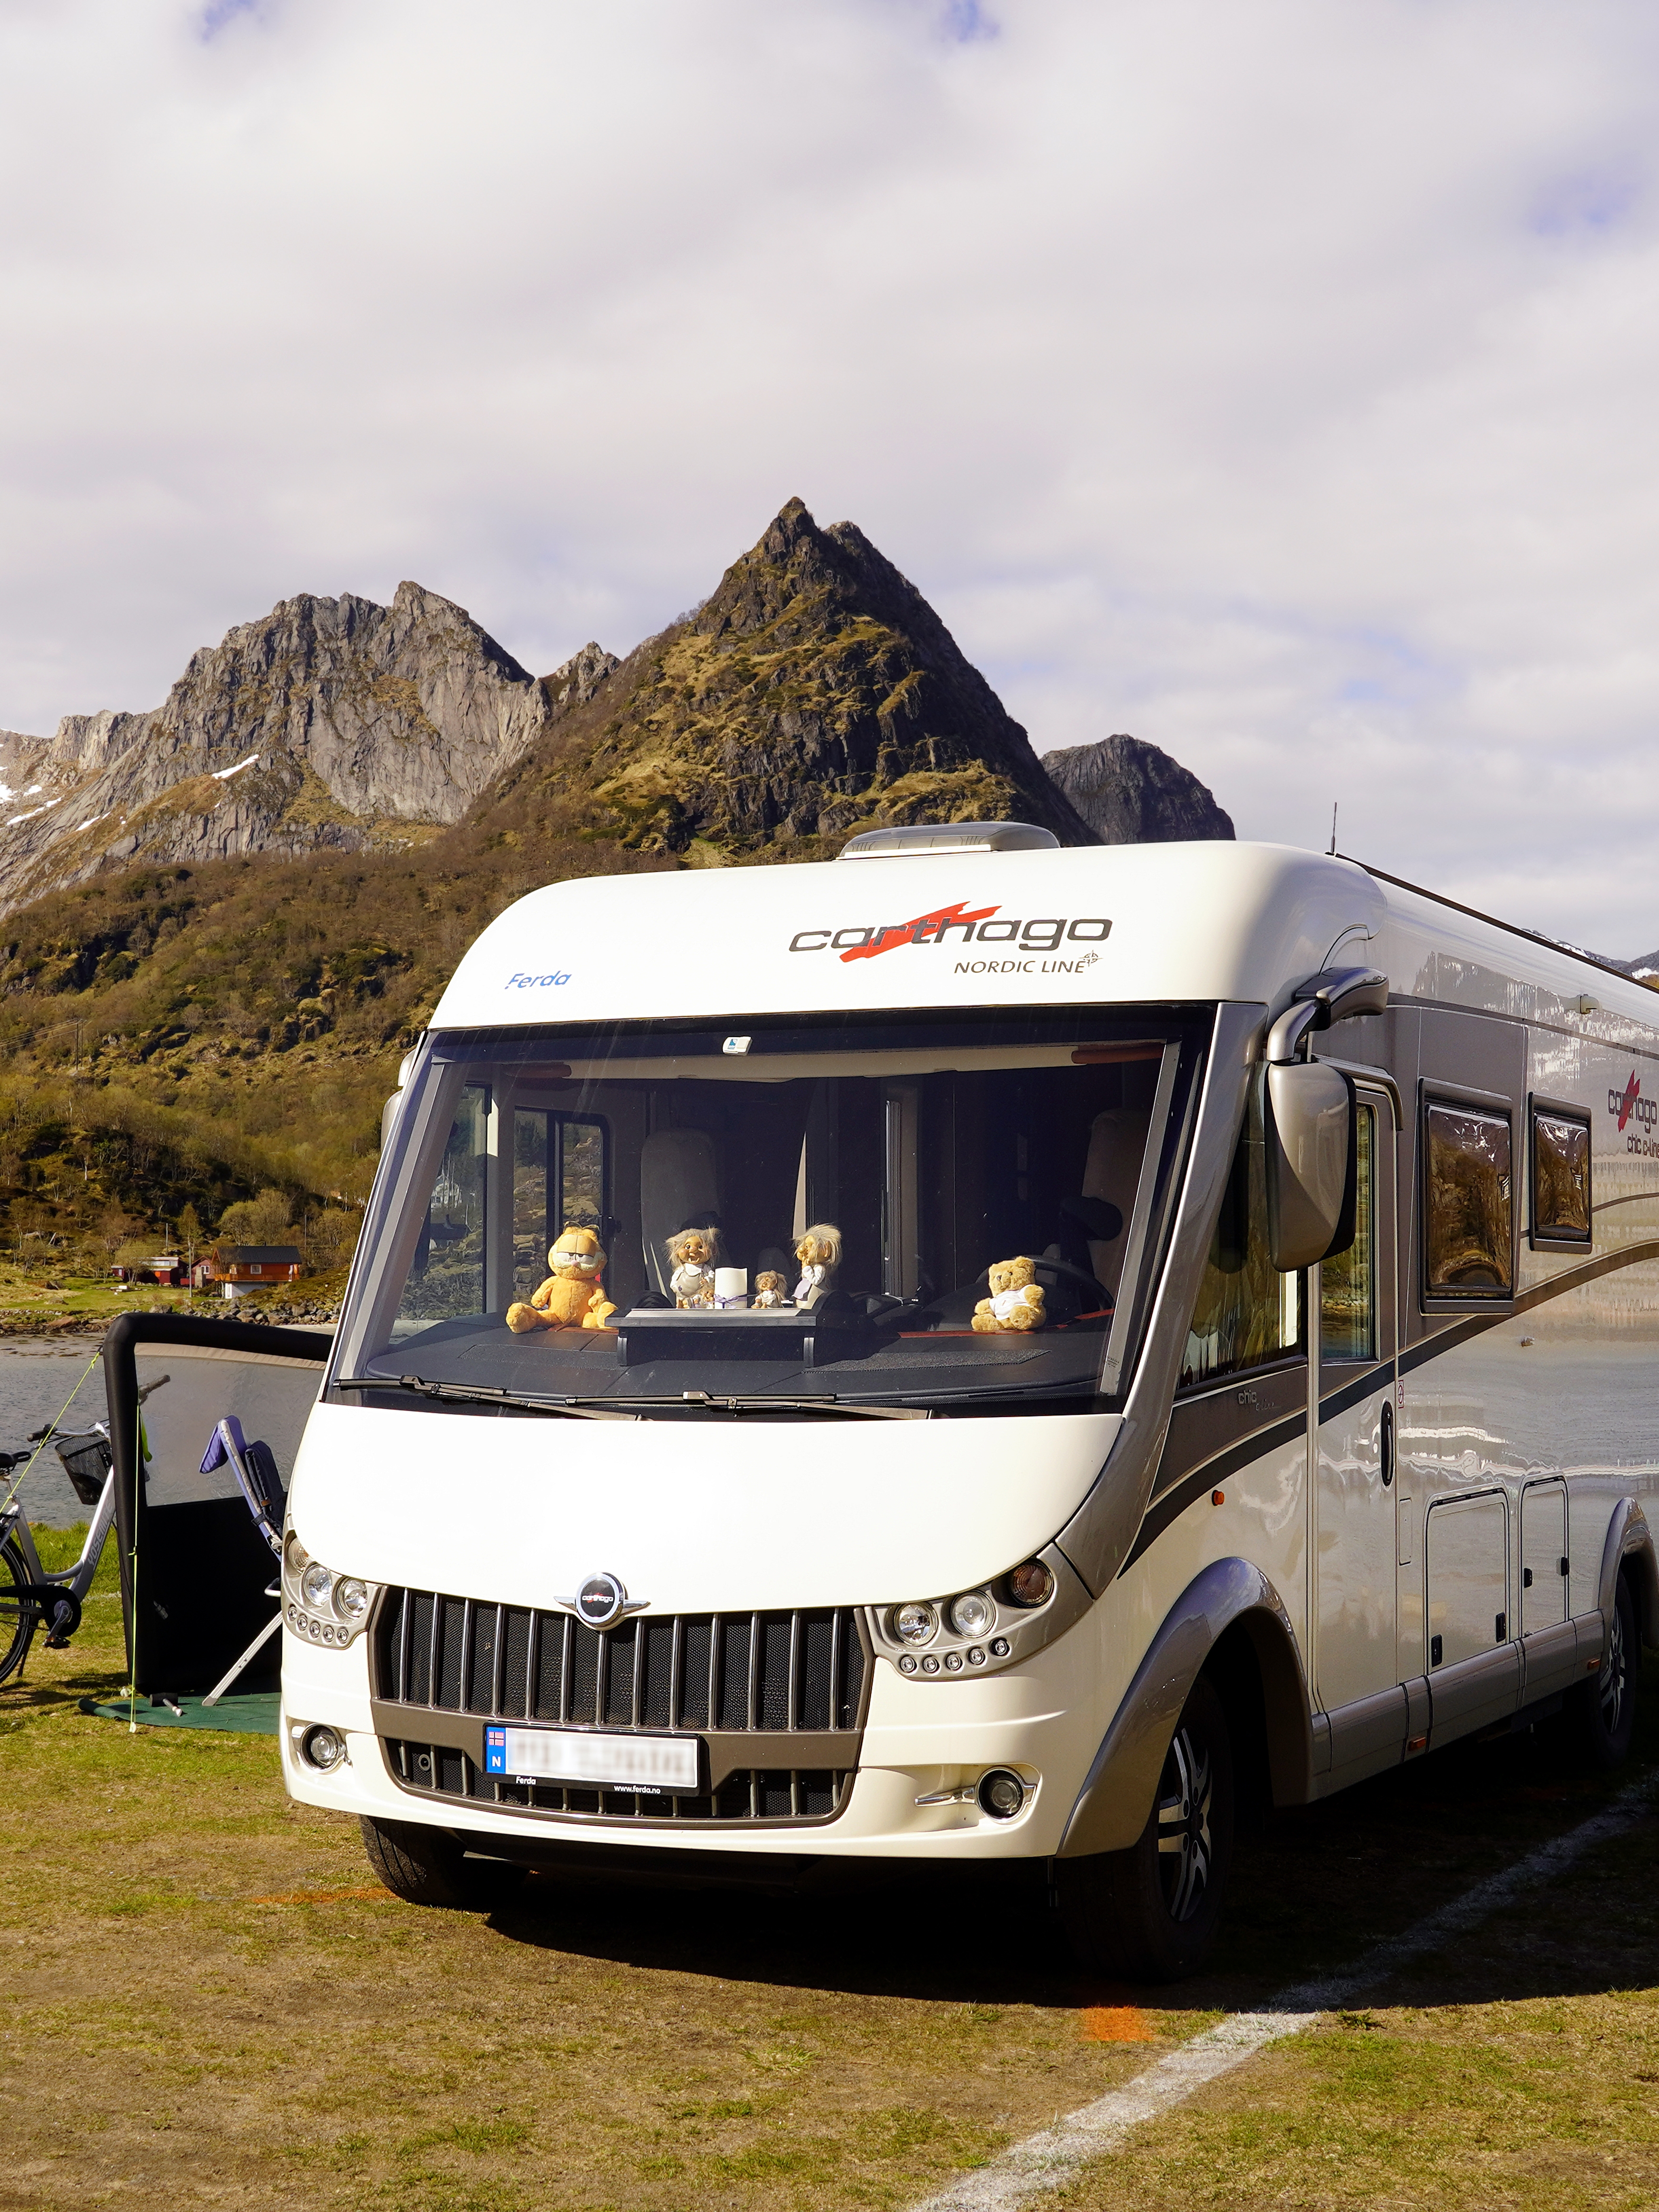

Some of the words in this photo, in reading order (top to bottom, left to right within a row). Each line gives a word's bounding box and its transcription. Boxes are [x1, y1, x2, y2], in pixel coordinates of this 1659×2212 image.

[789, 917, 1113, 952] carthago
[954, 960, 1036, 973] NORDIC
[1042, 960, 1086, 973] LINE
[504, 970, 572, 990] Ferda
[1627, 1133, 1641, 1154] chic
[1238, 1389, 1257, 1404] chic
[88, 1503, 113, 1566] YOSEMITE
[492, 1756, 501, 1767] N
[515, 1776, 536, 1785] Ferda
[613, 1785, 661, 1794] www.ferda.no
